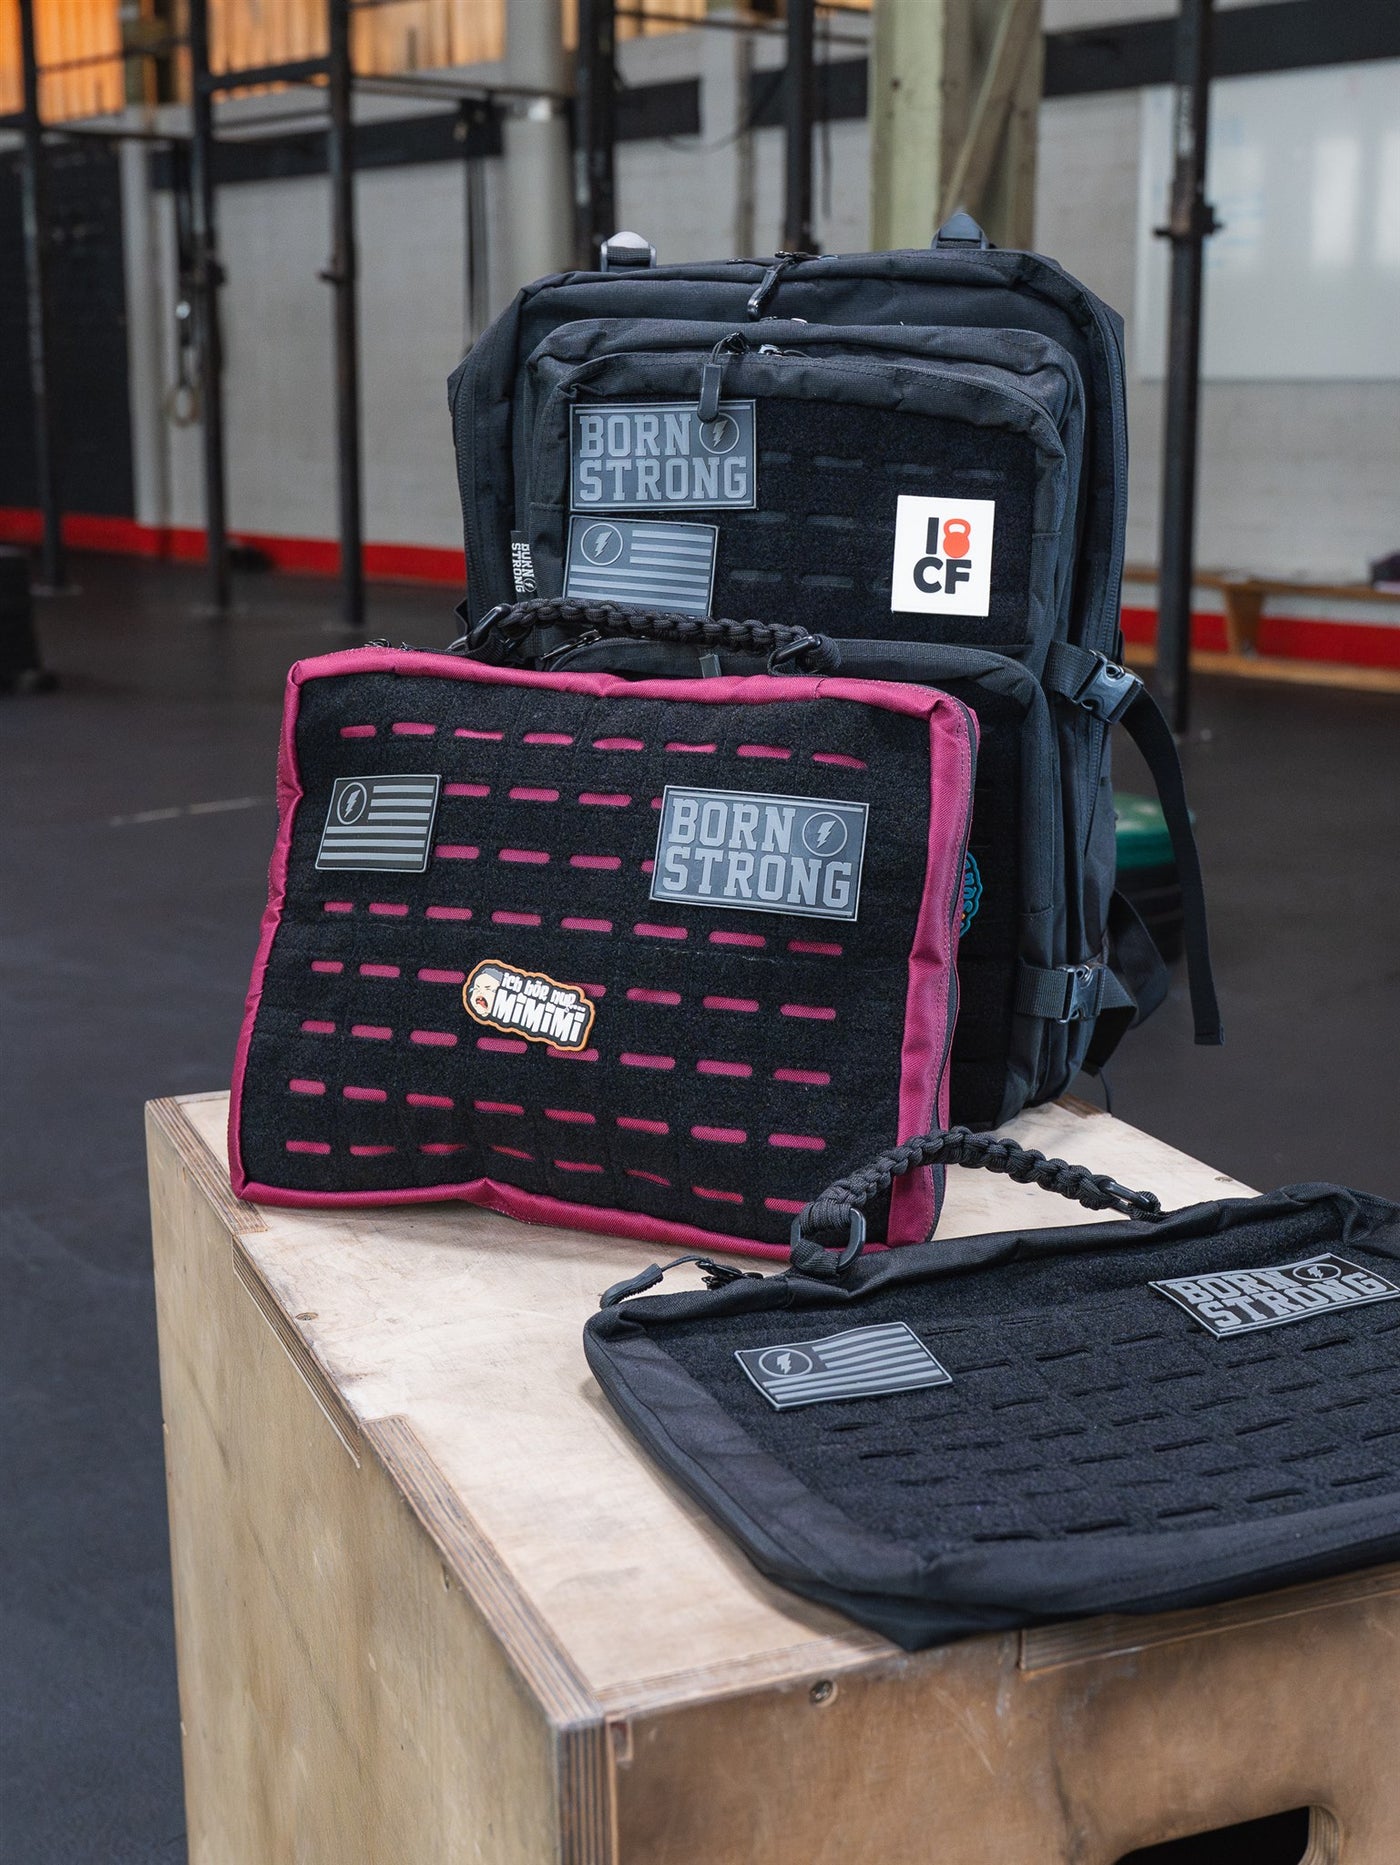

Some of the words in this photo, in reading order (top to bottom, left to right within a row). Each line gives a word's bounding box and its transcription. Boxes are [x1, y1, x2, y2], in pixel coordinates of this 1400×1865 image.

[579, 413, 692, 457] BORN
[579, 456, 747, 501] STRONG
[926, 517, 939, 555] I
[511, 542, 525, 593] STRONG
[913, 556, 972, 595] CF
[668, 797, 796, 853] BORN
[662, 845, 852, 909] STRONG
[1166, 1271, 1302, 1304] BORN
[1197, 1272, 1387, 1328] STRONG
